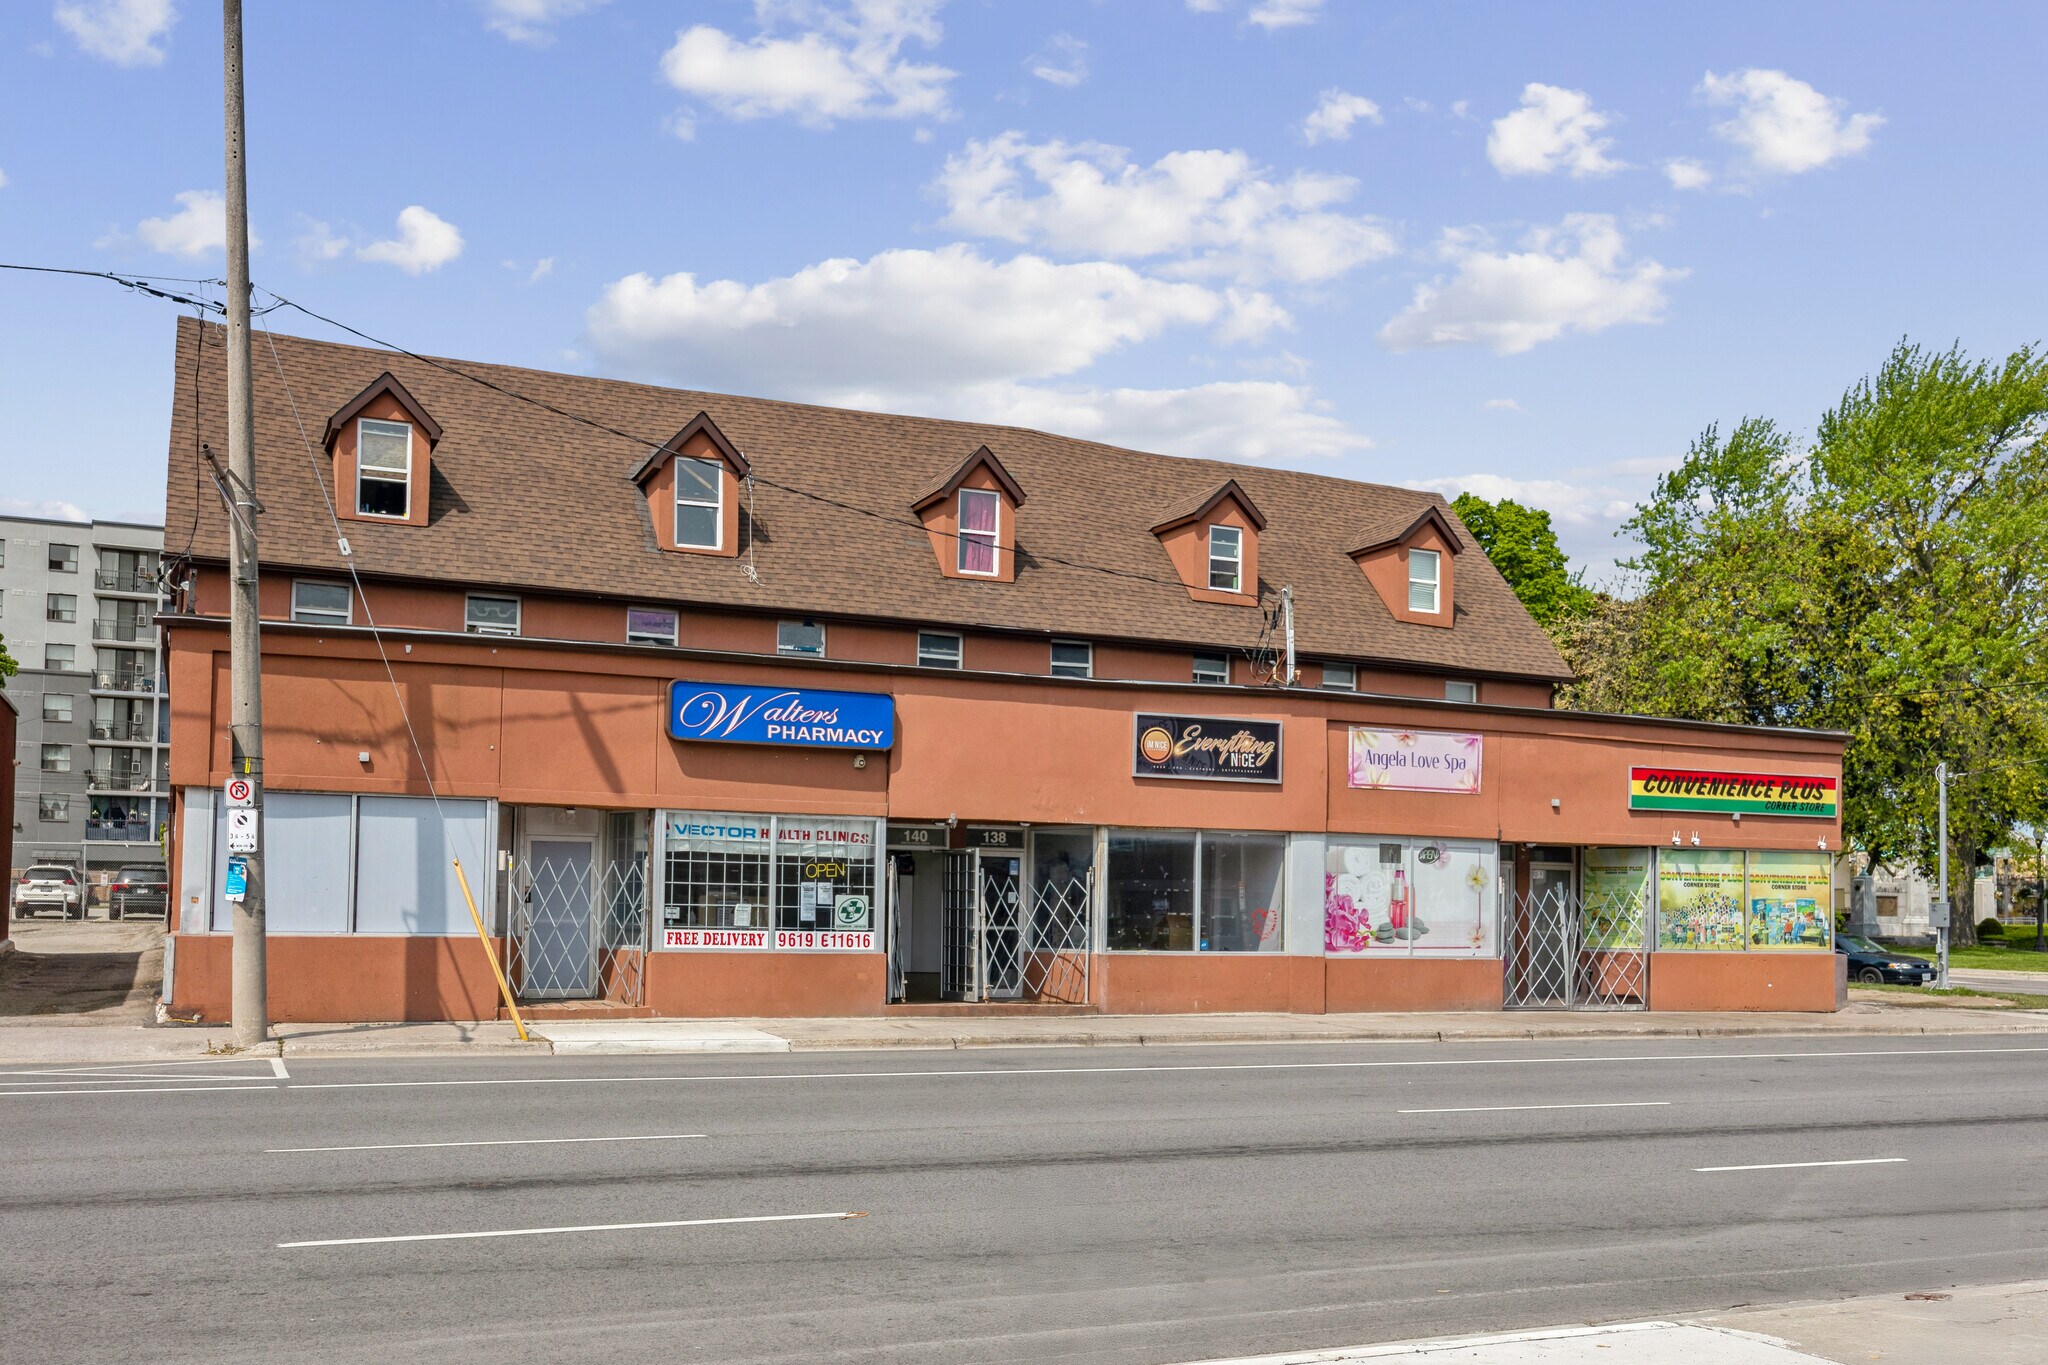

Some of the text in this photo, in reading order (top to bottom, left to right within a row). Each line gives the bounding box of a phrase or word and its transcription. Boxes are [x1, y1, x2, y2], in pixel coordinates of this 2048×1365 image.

[679, 691, 838, 738] Walters
[767, 724, 884, 745] PHARMACY
[1174, 724, 1276, 766] Everything
[1365, 749, 1466, 774] Angela Love Spa
[1642, 773, 1826, 801] CONVENIENCE PLUS
[1765, 801, 1826, 812] CORNER STORE
[675, 824, 870, 845] VECTOR HALTH CLINICS
[903, 830, 928, 842] 140
[983, 831, 1007, 843] 138
[805, 863, 846, 878] OPEN
[1721, 872, 1743, 883] PLUS
[1808, 875, 1828, 885] PLUS
[667, 931, 765, 946] FREE DELIVERY
